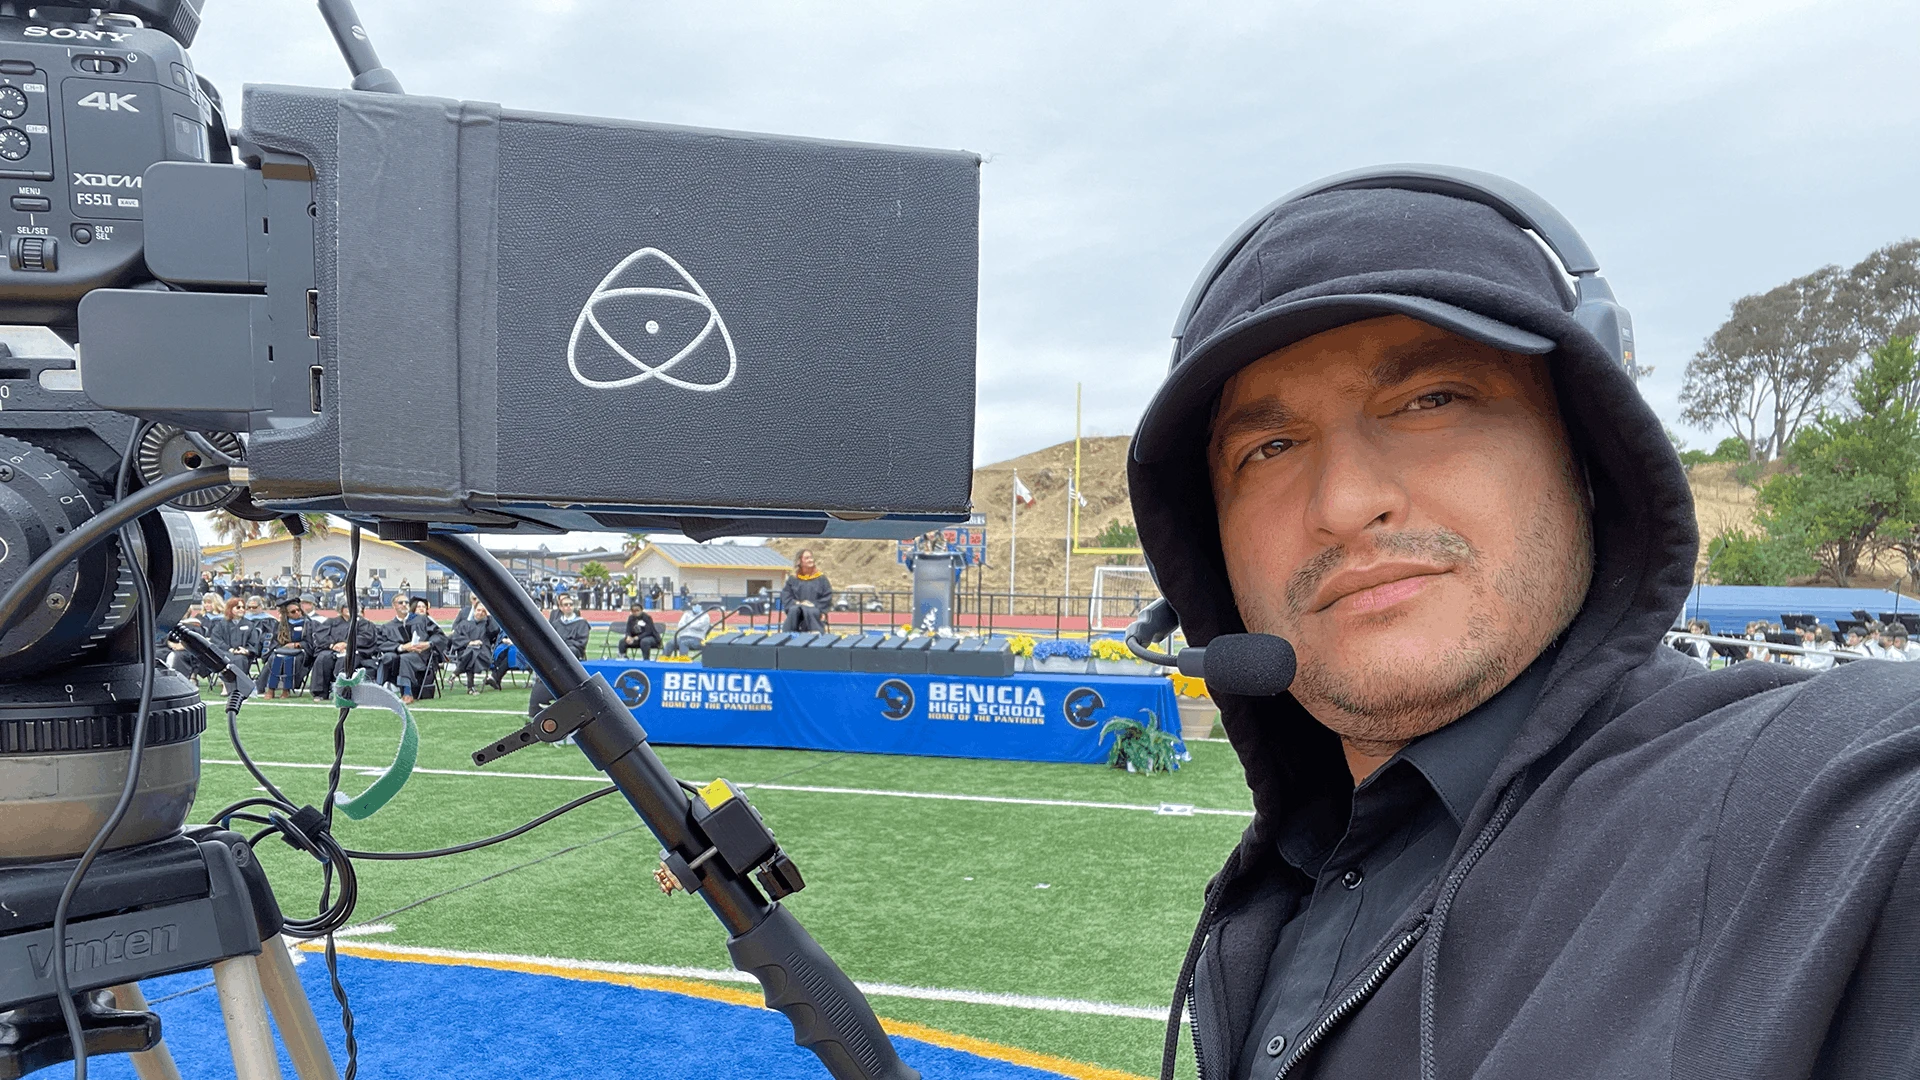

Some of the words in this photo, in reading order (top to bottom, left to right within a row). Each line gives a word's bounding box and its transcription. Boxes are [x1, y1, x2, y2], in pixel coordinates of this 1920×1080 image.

[23, 26, 133, 42] SONY
[77, 91, 140, 113] 4K
[18, 186, 41, 195] MENU
[17, 226, 49, 235] SEL/SET
[95, 225, 114, 233] SLOT
[664, 672, 773, 693] BENICIA
[663, 690, 702, 702] HIGH
[708, 691, 773, 704] SCHOOL
[929, 682, 1046, 706] BENICIA
[661, 701, 687, 709] HOME
[705, 702, 721, 710] THE
[724, 703, 773, 711] PANTHERS
[928, 701, 971, 714] HIGH
[977, 703, 1046, 718] SCHOOL
[928, 712, 955, 720] HOME
[958, 713, 970, 721] OF
[974, 714, 991, 722] THE
[994, 715, 1045, 725] PANTHERS
